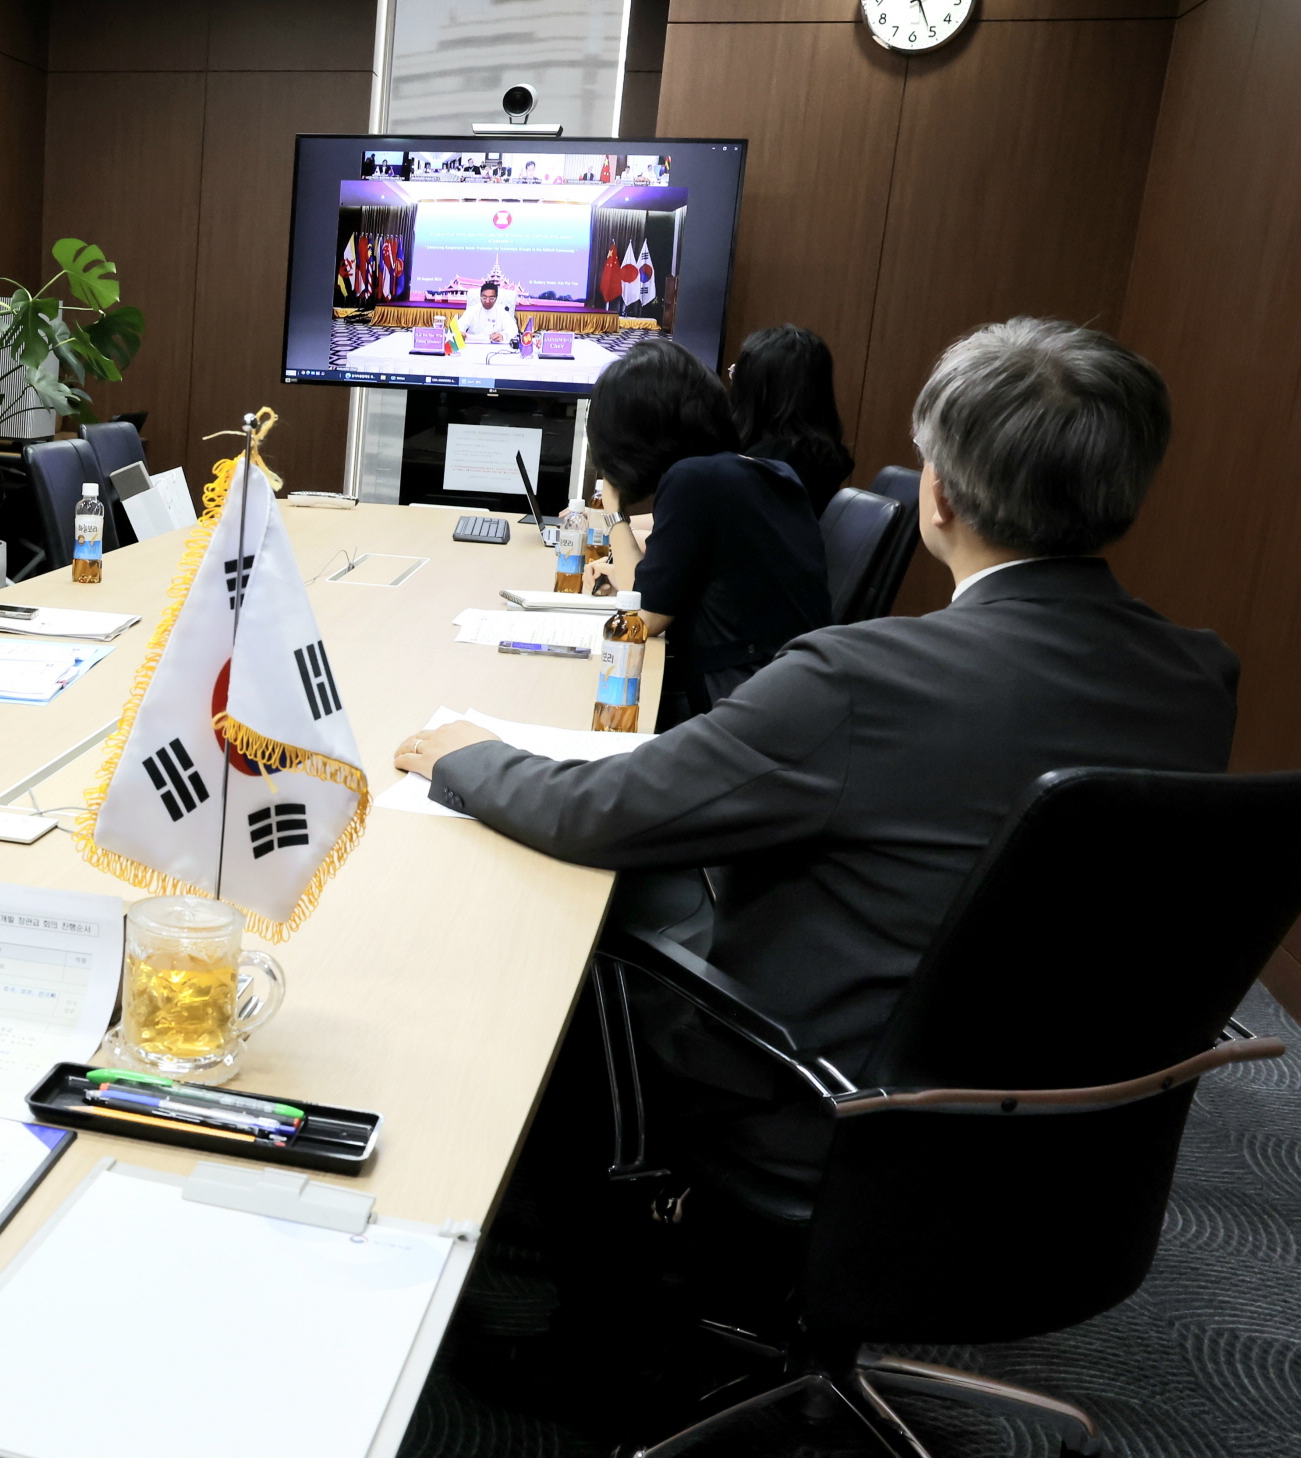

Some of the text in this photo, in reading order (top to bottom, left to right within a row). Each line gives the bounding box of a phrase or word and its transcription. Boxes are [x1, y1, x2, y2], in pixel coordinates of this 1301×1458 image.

[879, 13, 886, 24] 8
[944, 13, 951, 24] 4
[892, 26, 899, 37] 7
[908, 31, 916, 42] 6
[928, 26, 936, 37] 5
[78, 524, 97, 533] 하늘보리
[18, 916, 40, 927] 장관급
[43, 919, 58, 929] 회의
[62, 922, 91, 934] 진행순서
